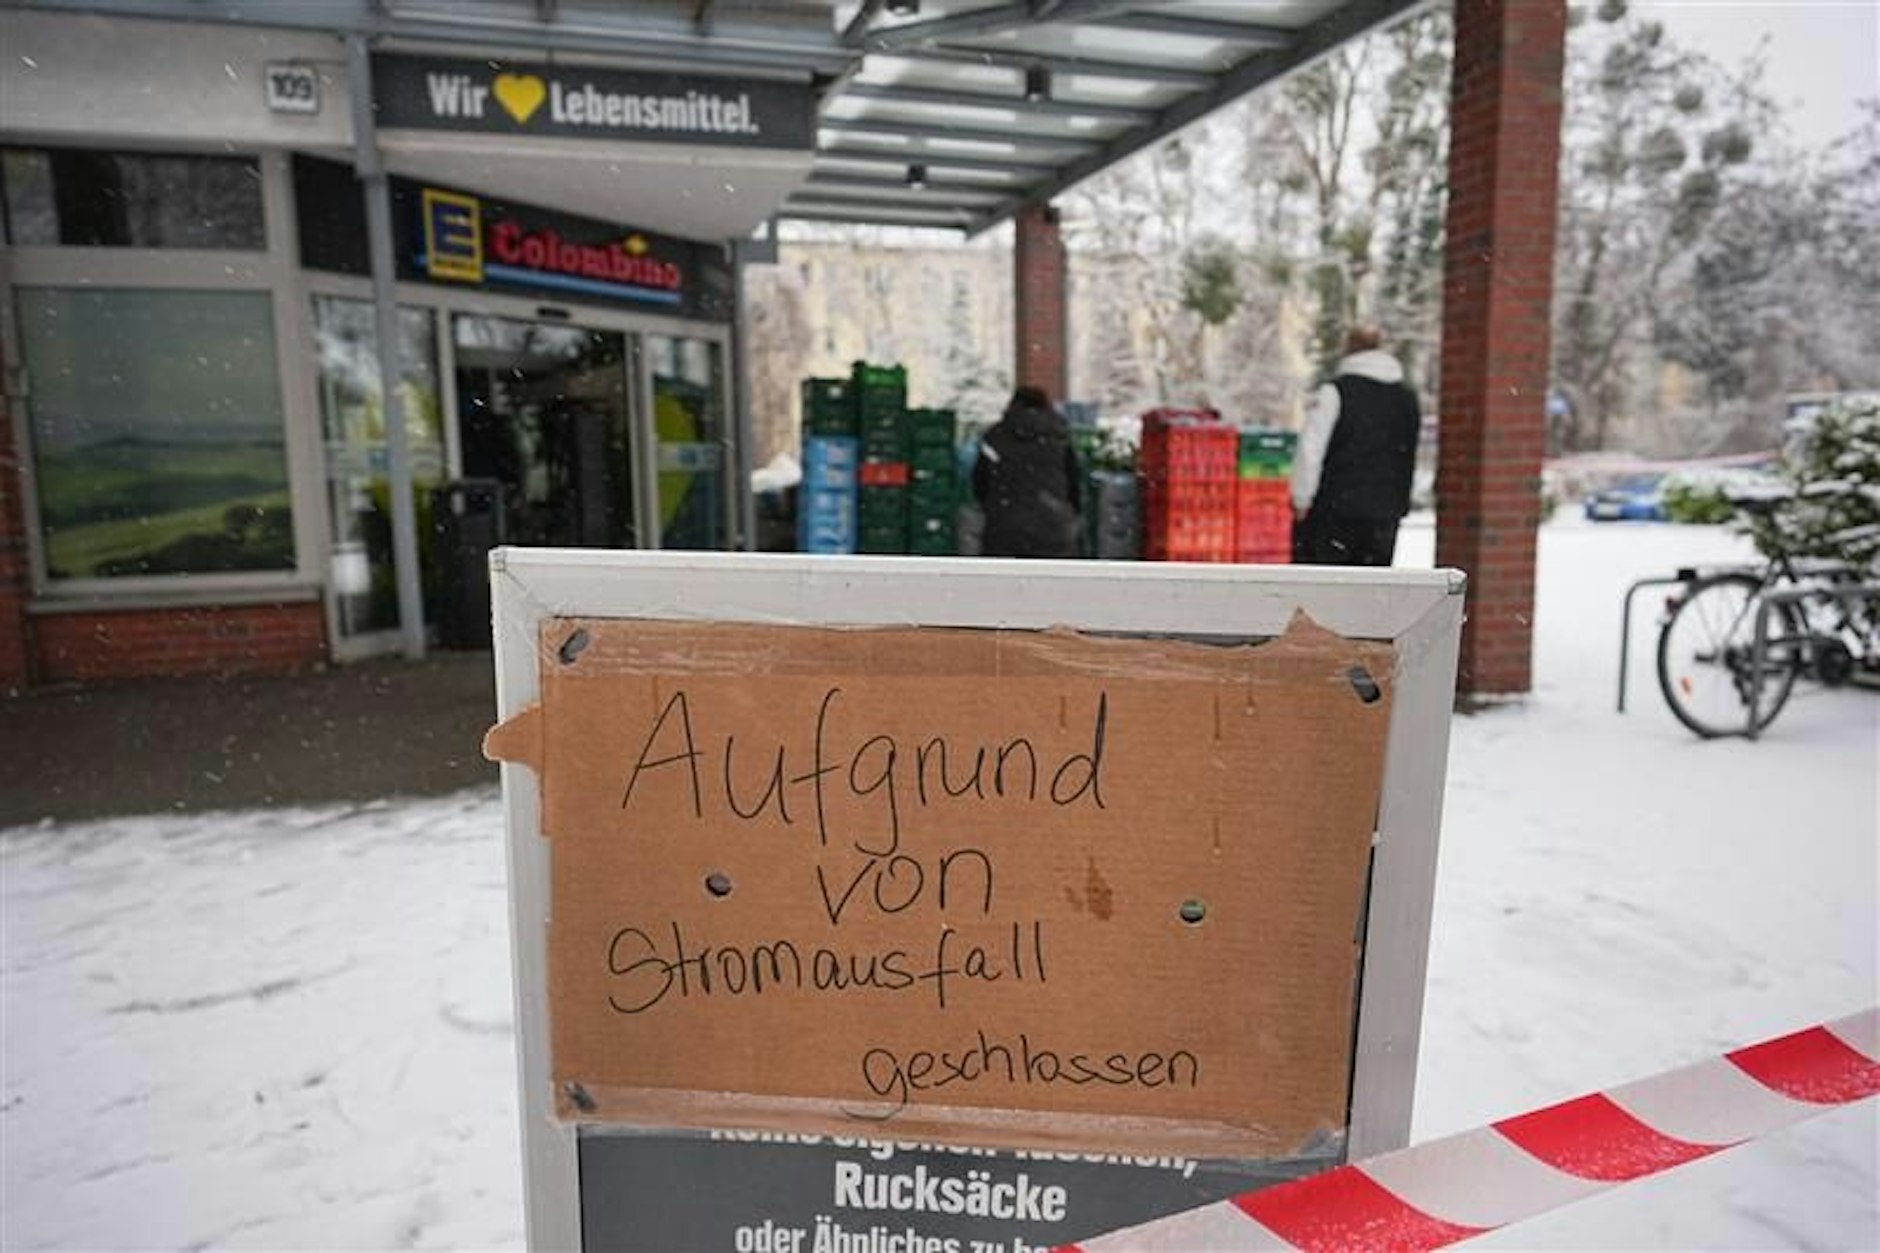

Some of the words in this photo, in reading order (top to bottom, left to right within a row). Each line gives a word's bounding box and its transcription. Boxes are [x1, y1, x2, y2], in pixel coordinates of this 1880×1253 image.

[427, 73, 487, 117] Wir
[551, 80, 759, 134] Lebensmittel.
[490, 220, 681, 288] Colombino
[622, 687, 1107, 856] Aufgrund
[817, 849, 994, 925] von
[608, 921, 1047, 1015] Stromausfall
[840, 1029, 1198, 1121] geschlossen
[834, 1160, 1068, 1222] Rucksäcke
[734, 1218, 807, 1253] oder
[811, 1214, 962, 1253] Ähnliches
